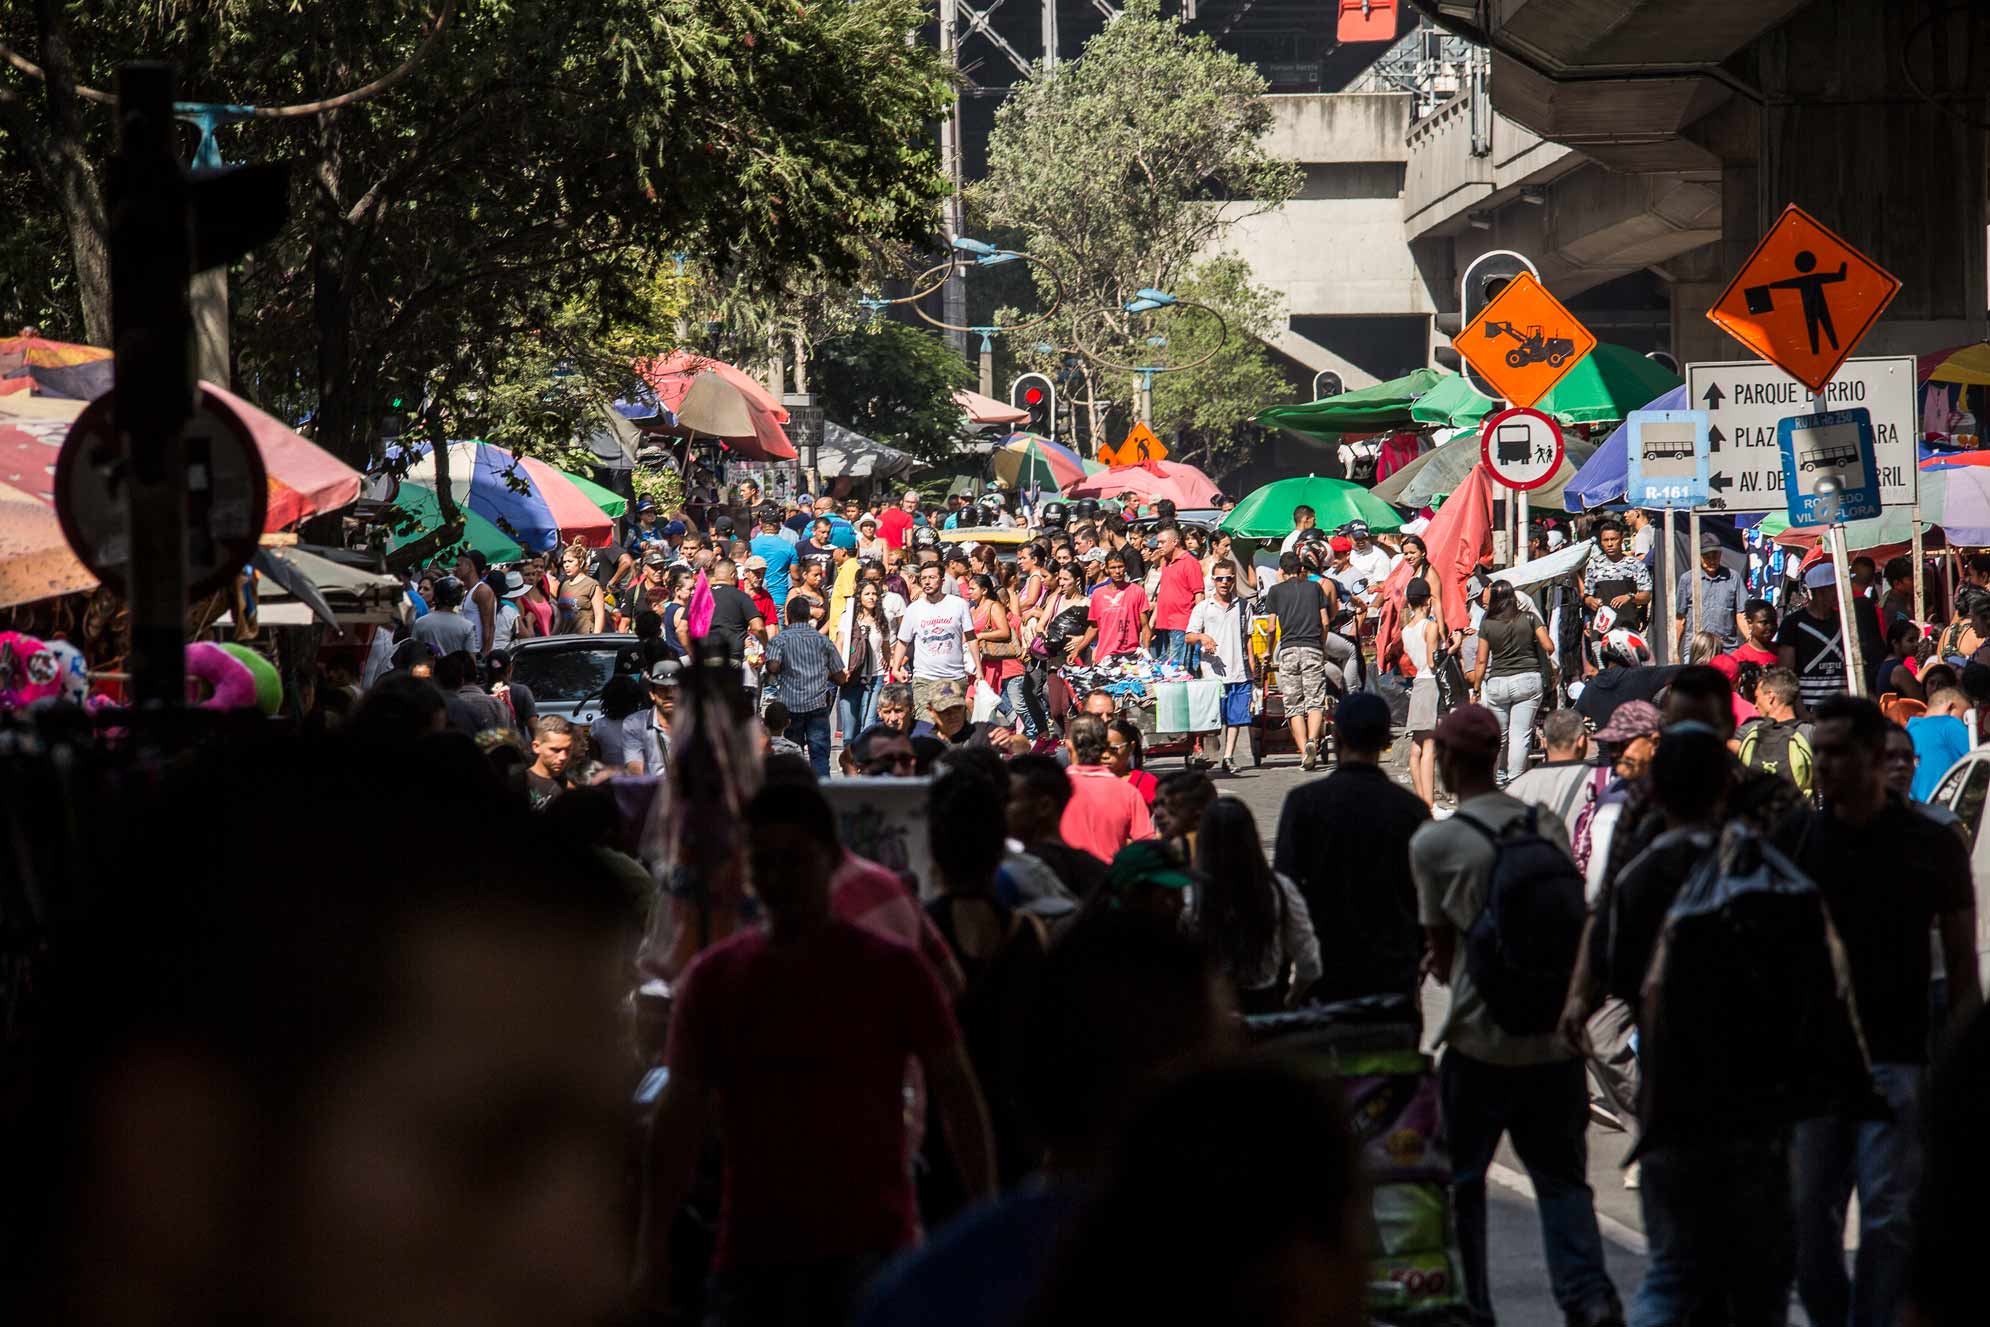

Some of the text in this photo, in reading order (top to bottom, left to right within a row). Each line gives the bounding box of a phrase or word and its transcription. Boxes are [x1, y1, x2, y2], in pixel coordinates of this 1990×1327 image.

[1735, 381, 1866, 405] PARQUE RRIO
[1735, 427, 1776, 448] PLAZ
[1740, 471, 1762, 492] AV.
[1767, 470, 1786, 491] DE
[1646, 486, 1689, 499] R-161
[1804, 493, 1864, 509] ROEDO
